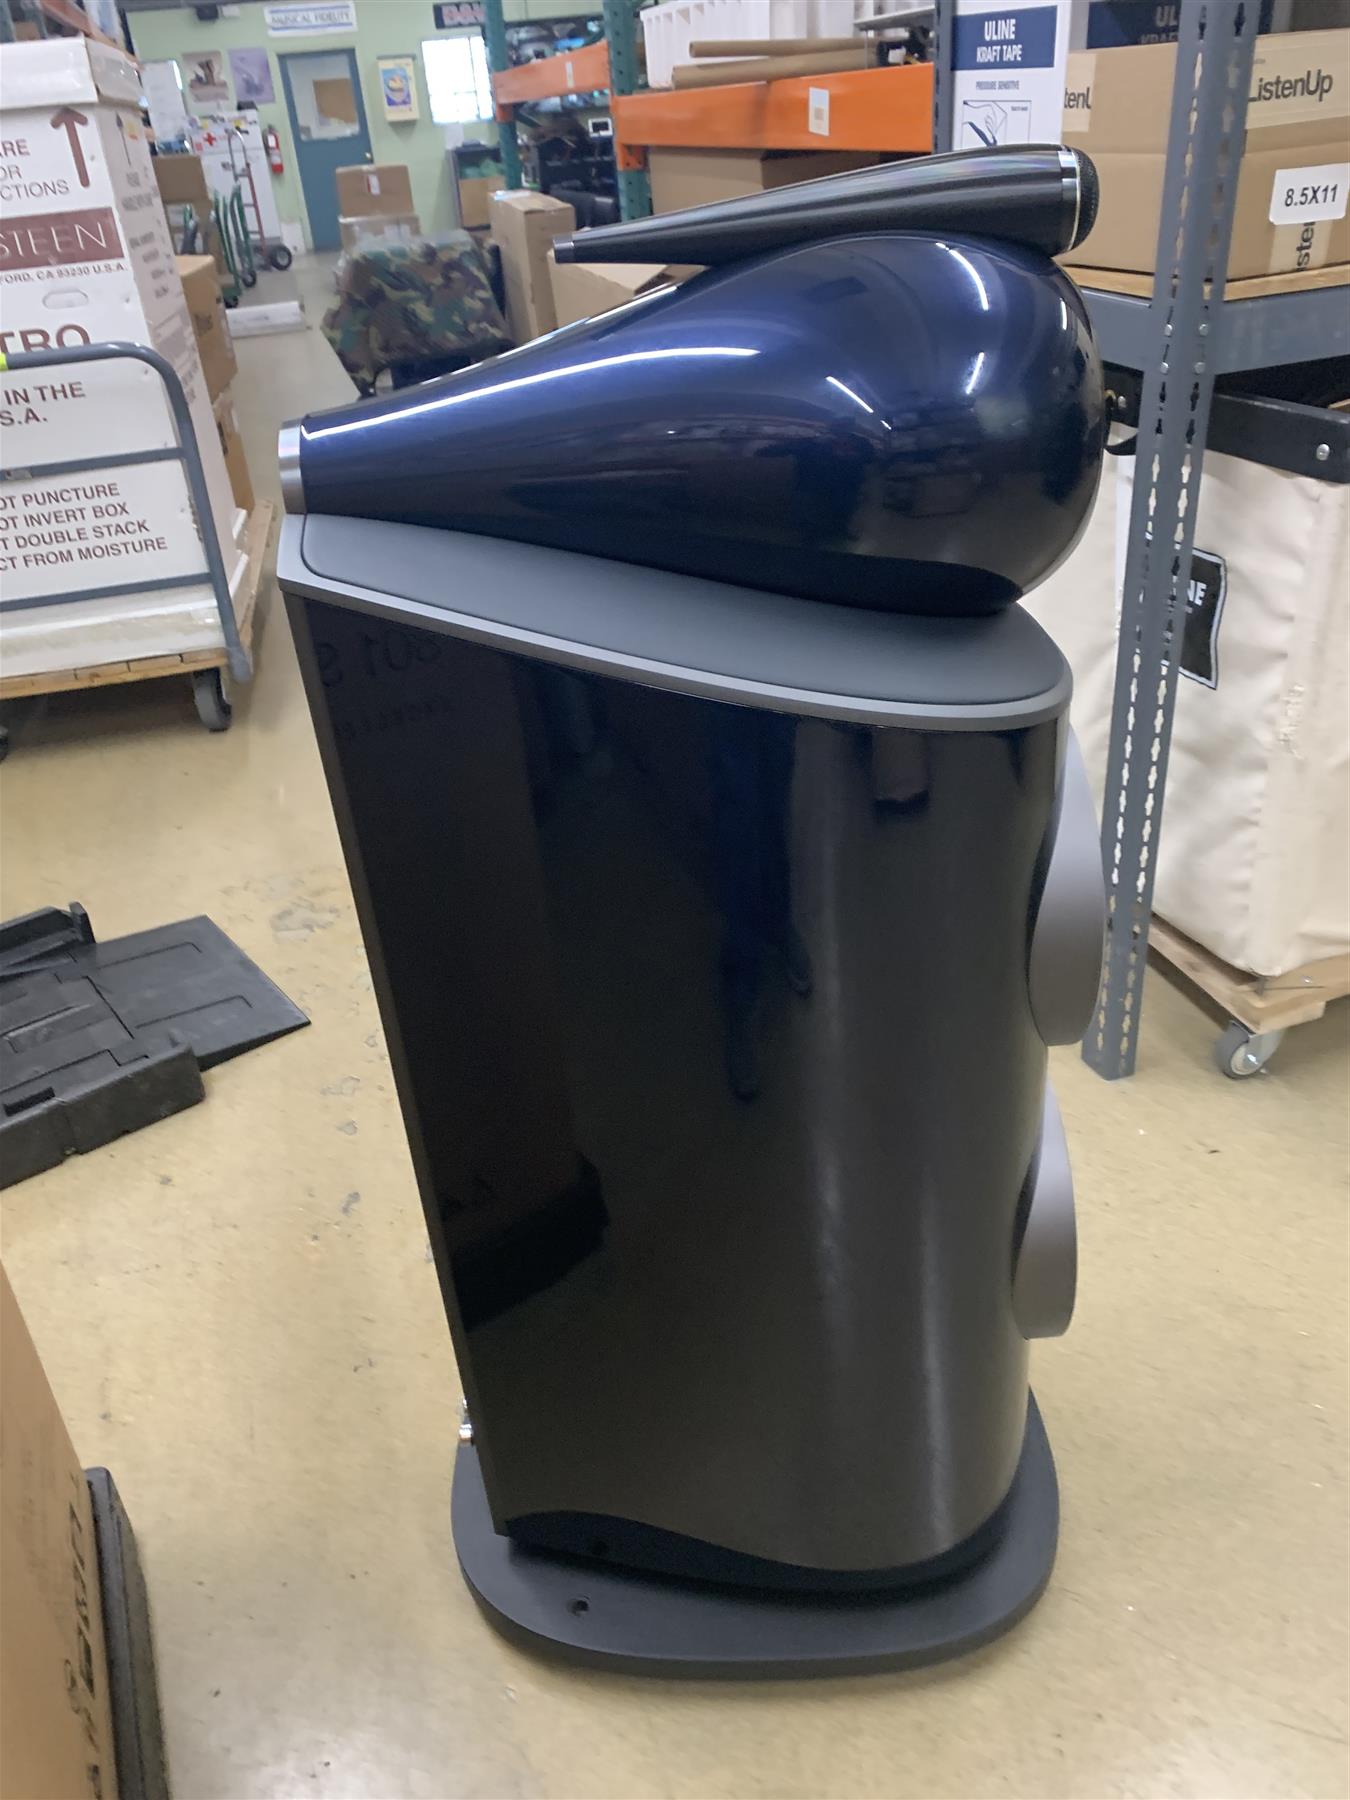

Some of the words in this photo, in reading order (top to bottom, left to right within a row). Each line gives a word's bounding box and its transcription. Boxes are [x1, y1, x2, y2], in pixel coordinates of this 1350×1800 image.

[984, 19, 1016, 41] ULINE
[976, 46, 1001, 62] KRAFT
[1002, 45, 1022, 61] TAPE
[0, 139, 30, 157] RE
[1284, 184, 1338, 207] 8.5X11
[4, 388, 30, 405] IN
[33, 381, 86, 402] THE
[22, 482, 120, 508] PUNCTURE
[24, 506, 86, 527] INVERT
[92, 502, 129, 519] BOX
[15, 527, 89, 549] DOUBLE
[93, 519, 150, 539] STACK
[23, 550, 74, 568] FROM
[78, 537, 168, 560] MOISTURE
